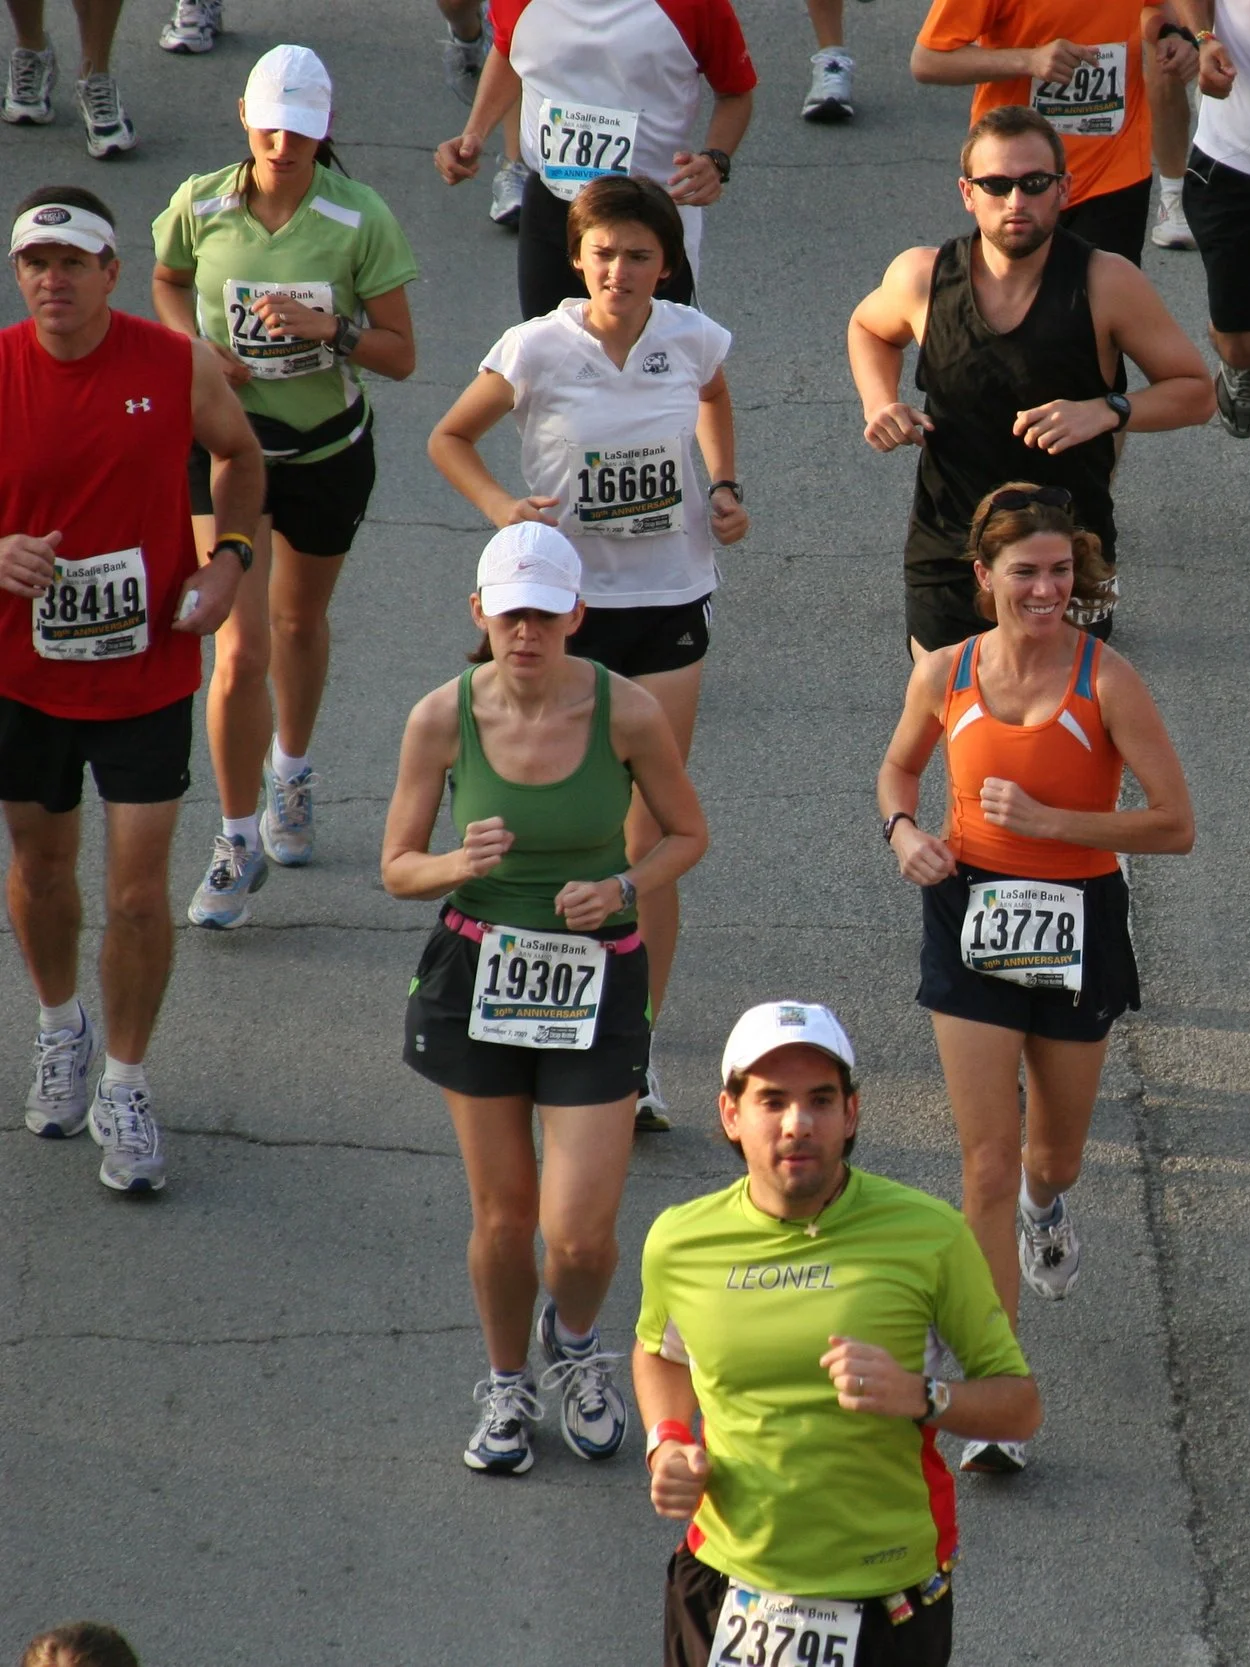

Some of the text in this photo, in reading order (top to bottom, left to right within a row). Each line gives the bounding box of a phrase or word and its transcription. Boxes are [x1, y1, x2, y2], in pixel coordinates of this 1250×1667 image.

[1096, 51, 1114, 59] Bank
[565, 110, 620, 127] LaSalle Bank
[540, 124, 631, 172] C 7872
[290, 290, 313, 298] Bank
[604, 446, 666, 461] LaSalle Bank
[578, 460, 676, 503] 16668
[611, 496, 677, 517] ANNIVERSARY
[66, 560, 127, 579] LaSalle Bank
[39, 577, 139, 622] 38419
[72, 616, 140, 636] ANNIVERSARY
[1001, 890, 1065, 902] LaSalle Bank
[970, 908, 1074, 952] 13778
[520, 938, 587, 955] LaSalle Bank
[983, 955, 1073, 969] 30th ANNIVERSARY
[484, 954, 595, 1006] 19307
[516, 1008, 588, 1018] ANNIVERSARY
[726, 1265, 834, 1290] LEONEL
[764, 1599, 838, 1622] LaSalle Bank
[720, 1615, 848, 1667] 23795
